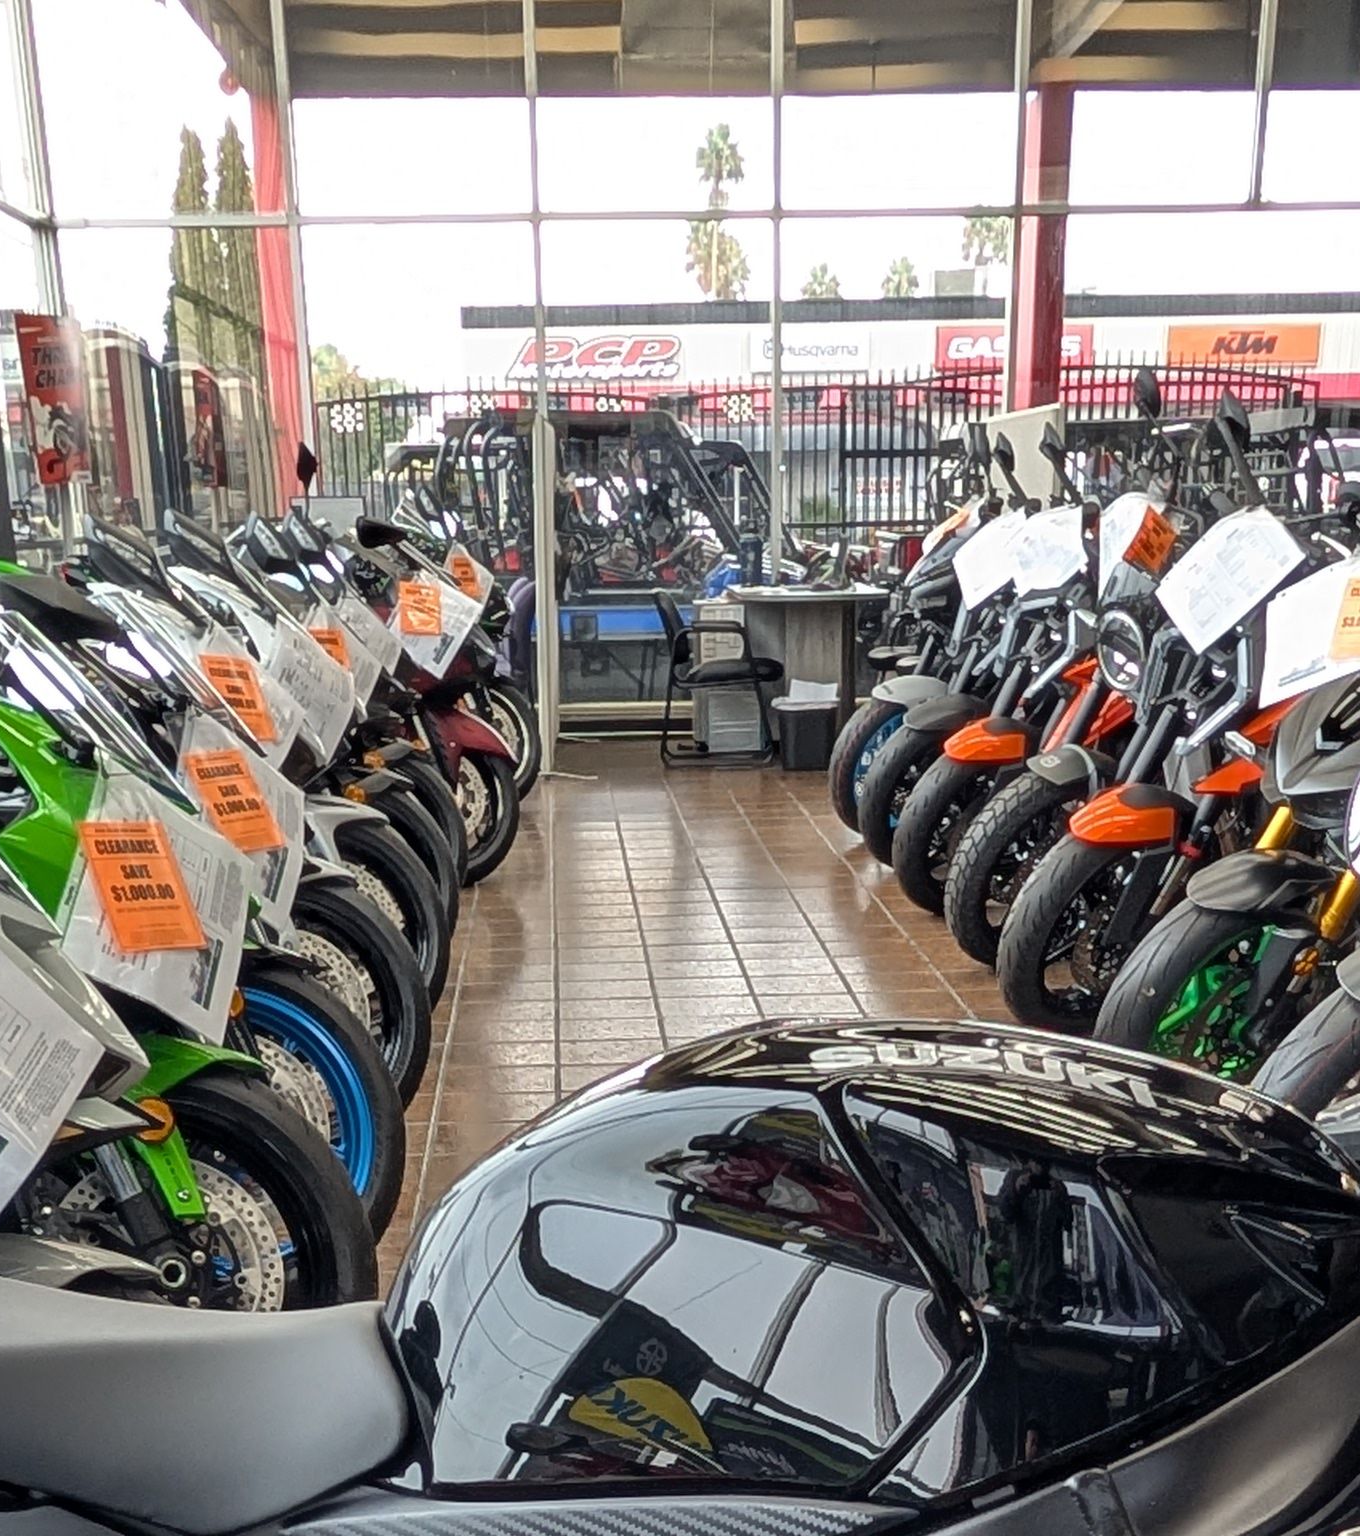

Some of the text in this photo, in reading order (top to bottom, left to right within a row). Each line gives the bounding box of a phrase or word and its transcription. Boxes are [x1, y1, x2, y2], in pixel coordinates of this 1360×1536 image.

[947, 335, 1083, 360] GASS
[1211, 330, 1279, 355] KTM
[196, 762, 245, 780] CLEARANCE
[94, 838, 160, 856] CLEARANCE
[119, 863, 153, 880] SAVE
[110, 883, 176, 903] $1,000.00
[809, 1042, 1161, 1110] SUZUKI
